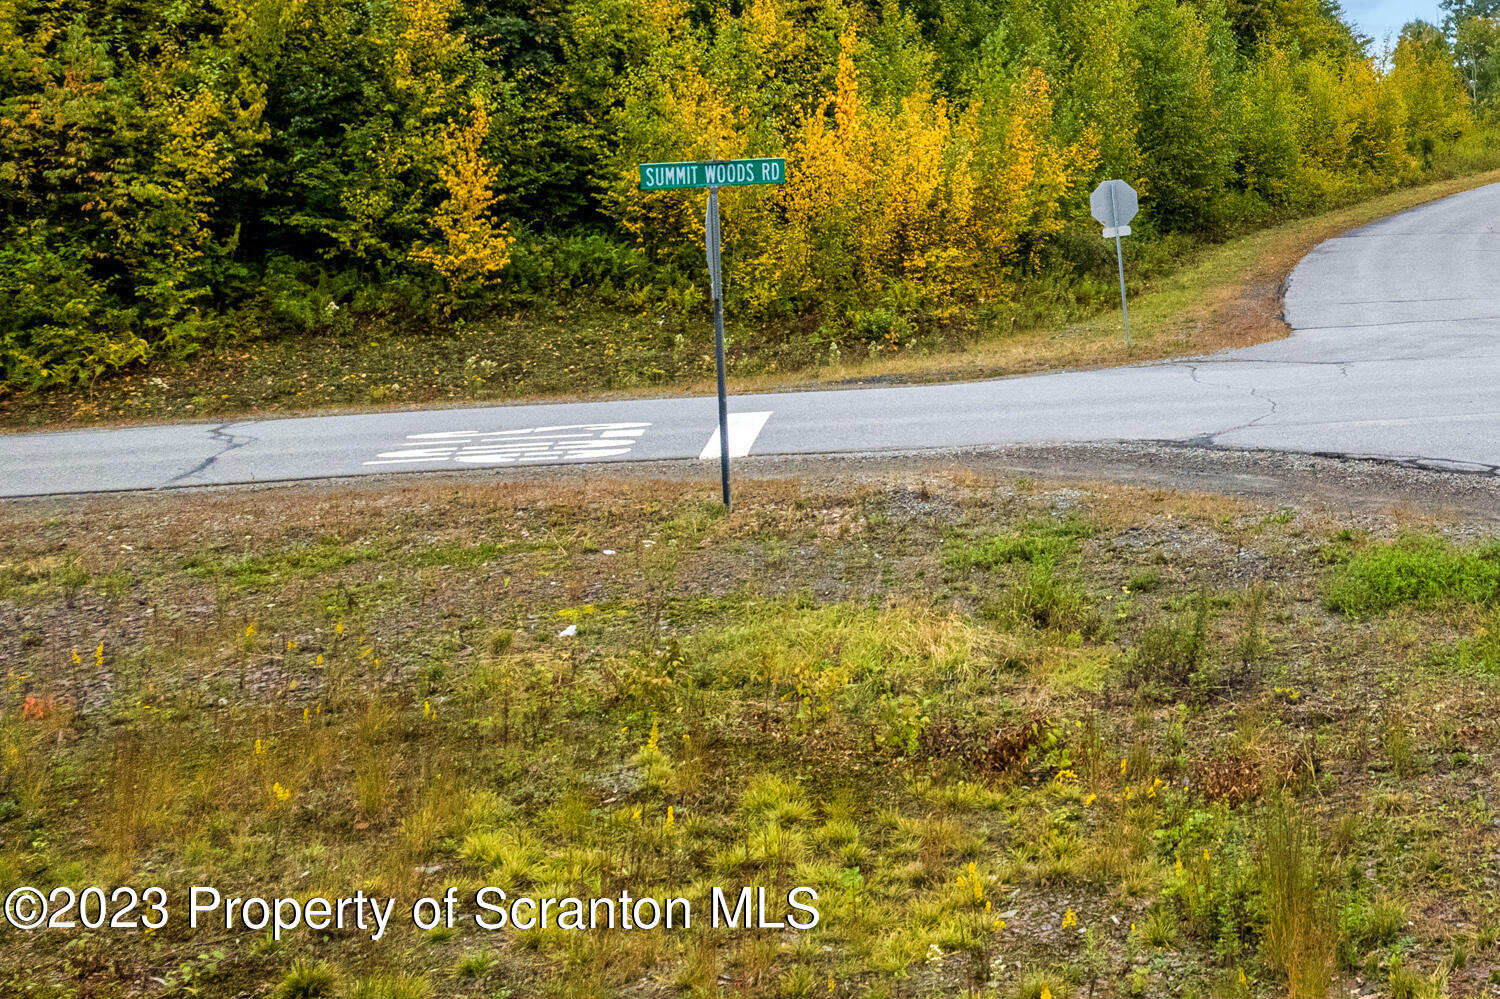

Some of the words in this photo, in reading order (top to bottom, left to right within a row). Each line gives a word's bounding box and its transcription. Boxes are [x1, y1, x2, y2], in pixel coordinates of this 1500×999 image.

[645, 165, 698, 187] SUMMIT
[704, 163, 755, 184] WOODS
[761, 162, 780, 181] RD
